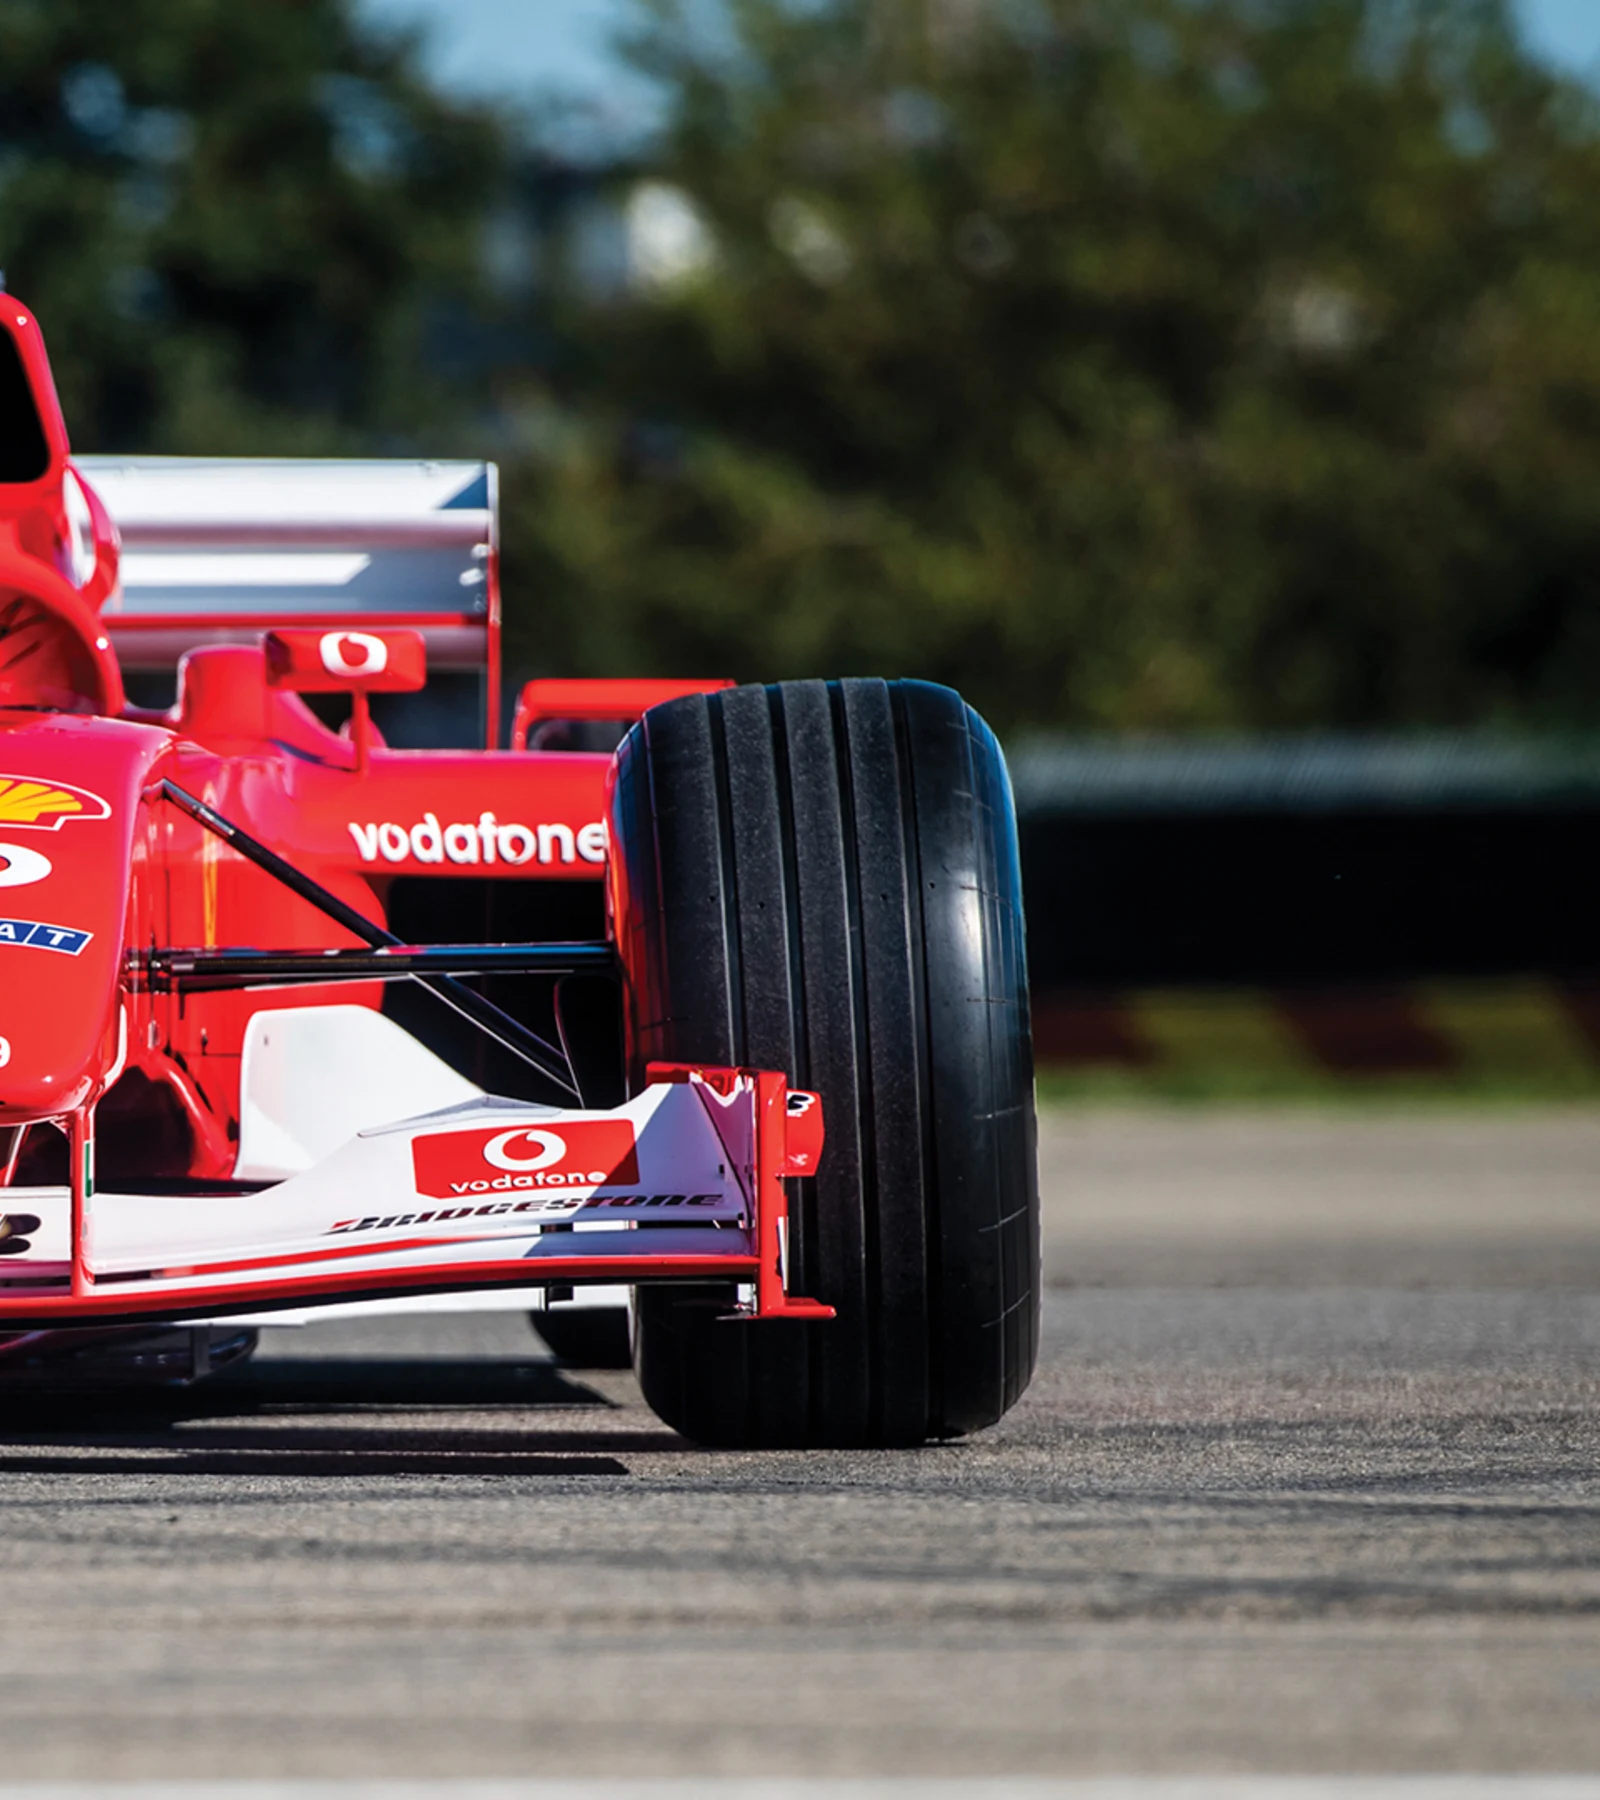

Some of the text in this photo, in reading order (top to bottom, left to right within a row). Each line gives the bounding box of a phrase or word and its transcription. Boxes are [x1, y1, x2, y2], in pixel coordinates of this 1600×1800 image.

[348, 811, 606, 864] vodafone
[450, 1171, 607, 1194] vodafone
[324, 1193, 724, 1234] BRIDGESTONE
